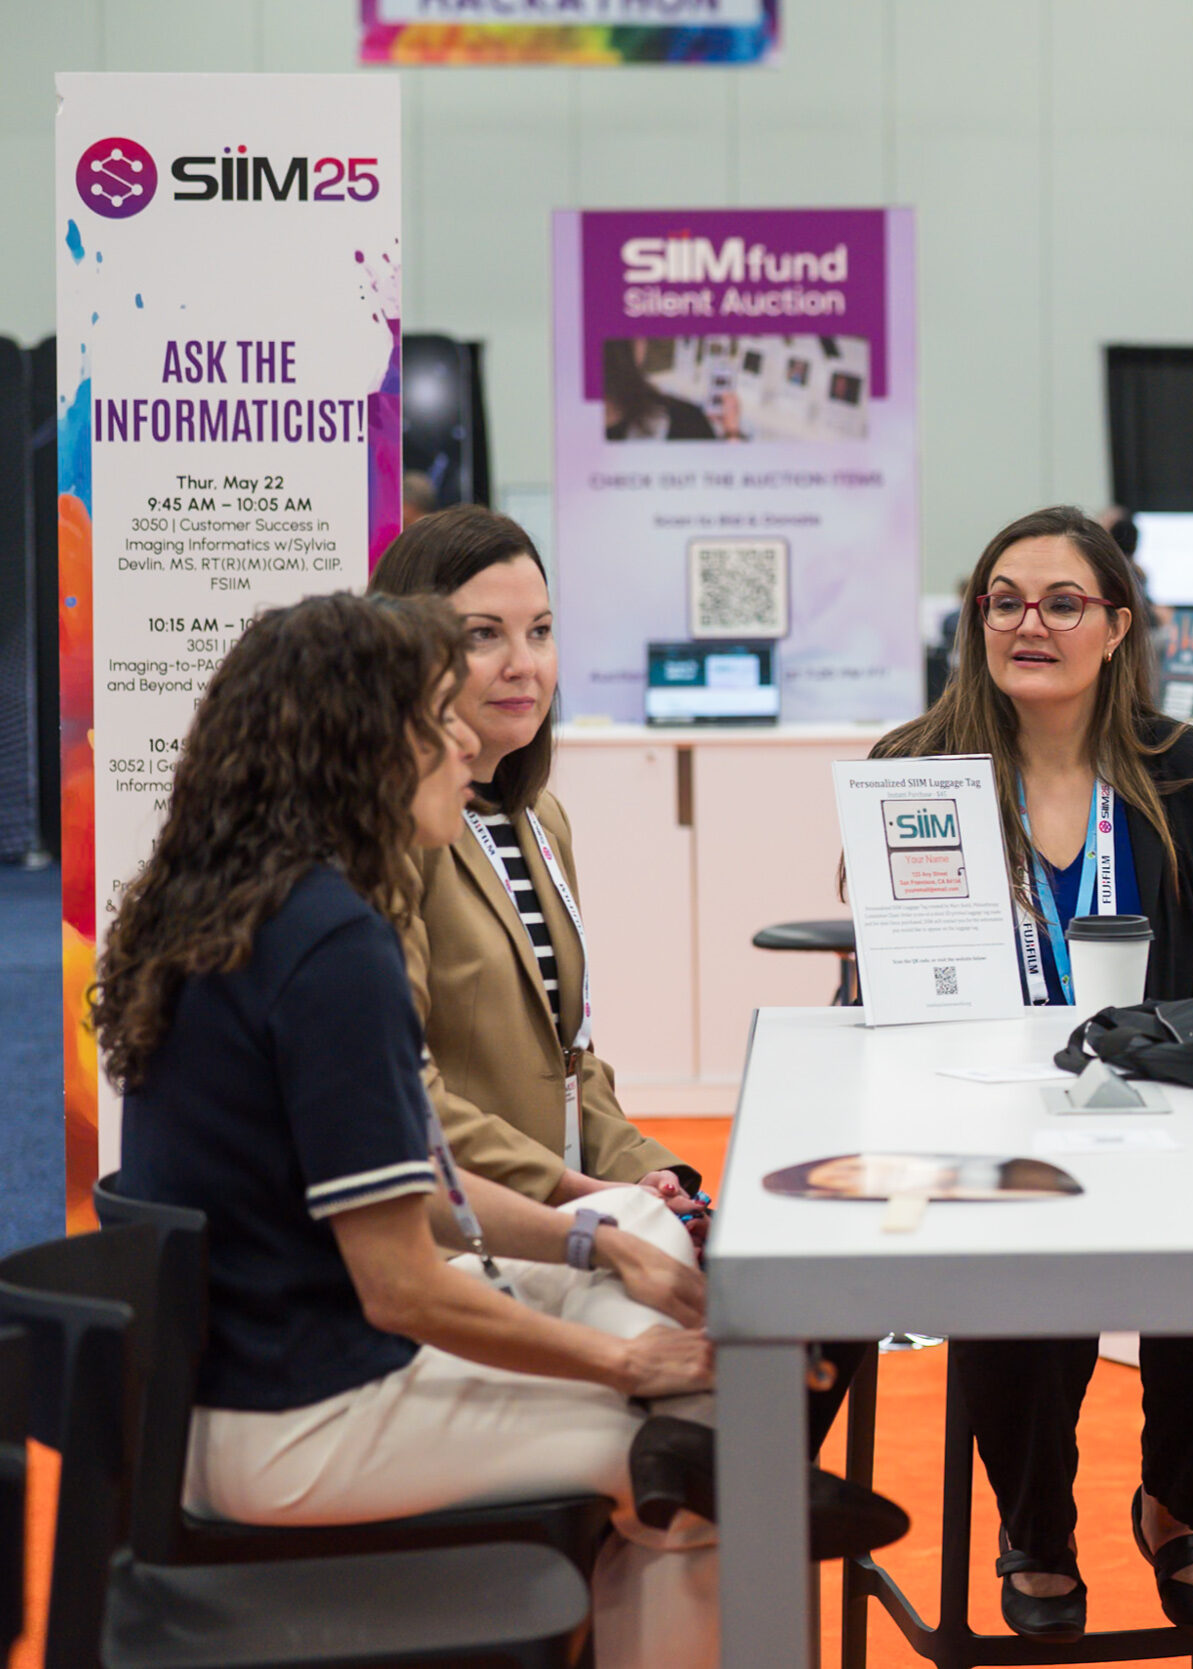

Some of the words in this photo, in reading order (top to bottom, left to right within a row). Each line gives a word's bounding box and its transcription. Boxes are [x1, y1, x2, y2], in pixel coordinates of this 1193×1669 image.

[622, 286, 715, 318] Silent
[720, 286, 847, 318] Auction
[162, 340, 232, 384] ASK
[240, 340, 297, 384] THE
[94, 398, 365, 444] INFORMATICIST!
[223, 475, 259, 493] May
[264, 475, 285, 490] 22
[659, 472, 698, 490] OUT
[702, 472, 735, 490] THE
[742, 471, 826, 490] AUCTION
[832, 471, 886, 489] ITEMS
[147, 497, 182, 512] 9:45
[188, 497, 216, 512] AM
[236, 497, 279, 512] 10:05
[284, 497, 313, 512] AM
[131, 518, 168, 532] 3050
[179, 518, 250, 532] Customer
[255, 518, 313, 532] Success
[317, 518, 330, 532] in
[125, 538, 184, 555] Imaging
[189, 537, 271, 552] Informatics
[274, 537, 336, 555] w/Sylvia
[118, 557, 165, 572] Devlin,
[170, 558, 197, 572] MS,
[210, 577, 251, 591] FSIIM
[148, 618, 185, 633] 10:15
[191, 618, 219, 632] AM
[187, 639, 218, 652] 3051
[107, 677, 135, 692] and
[139, 677, 193, 696] Beyond
[109, 759, 145, 773] 3052
[849, 778, 906, 789] Personalized
[908, 778, 928, 788] SIIM
[929, 778, 964, 790] Luggage
[964, 777, 982, 789] Tag
[464, 809, 496, 856] UJIFILM
[1101, 855, 1112, 904] FUJIFILM
[1023, 922, 1040, 975] FUJIFILM
